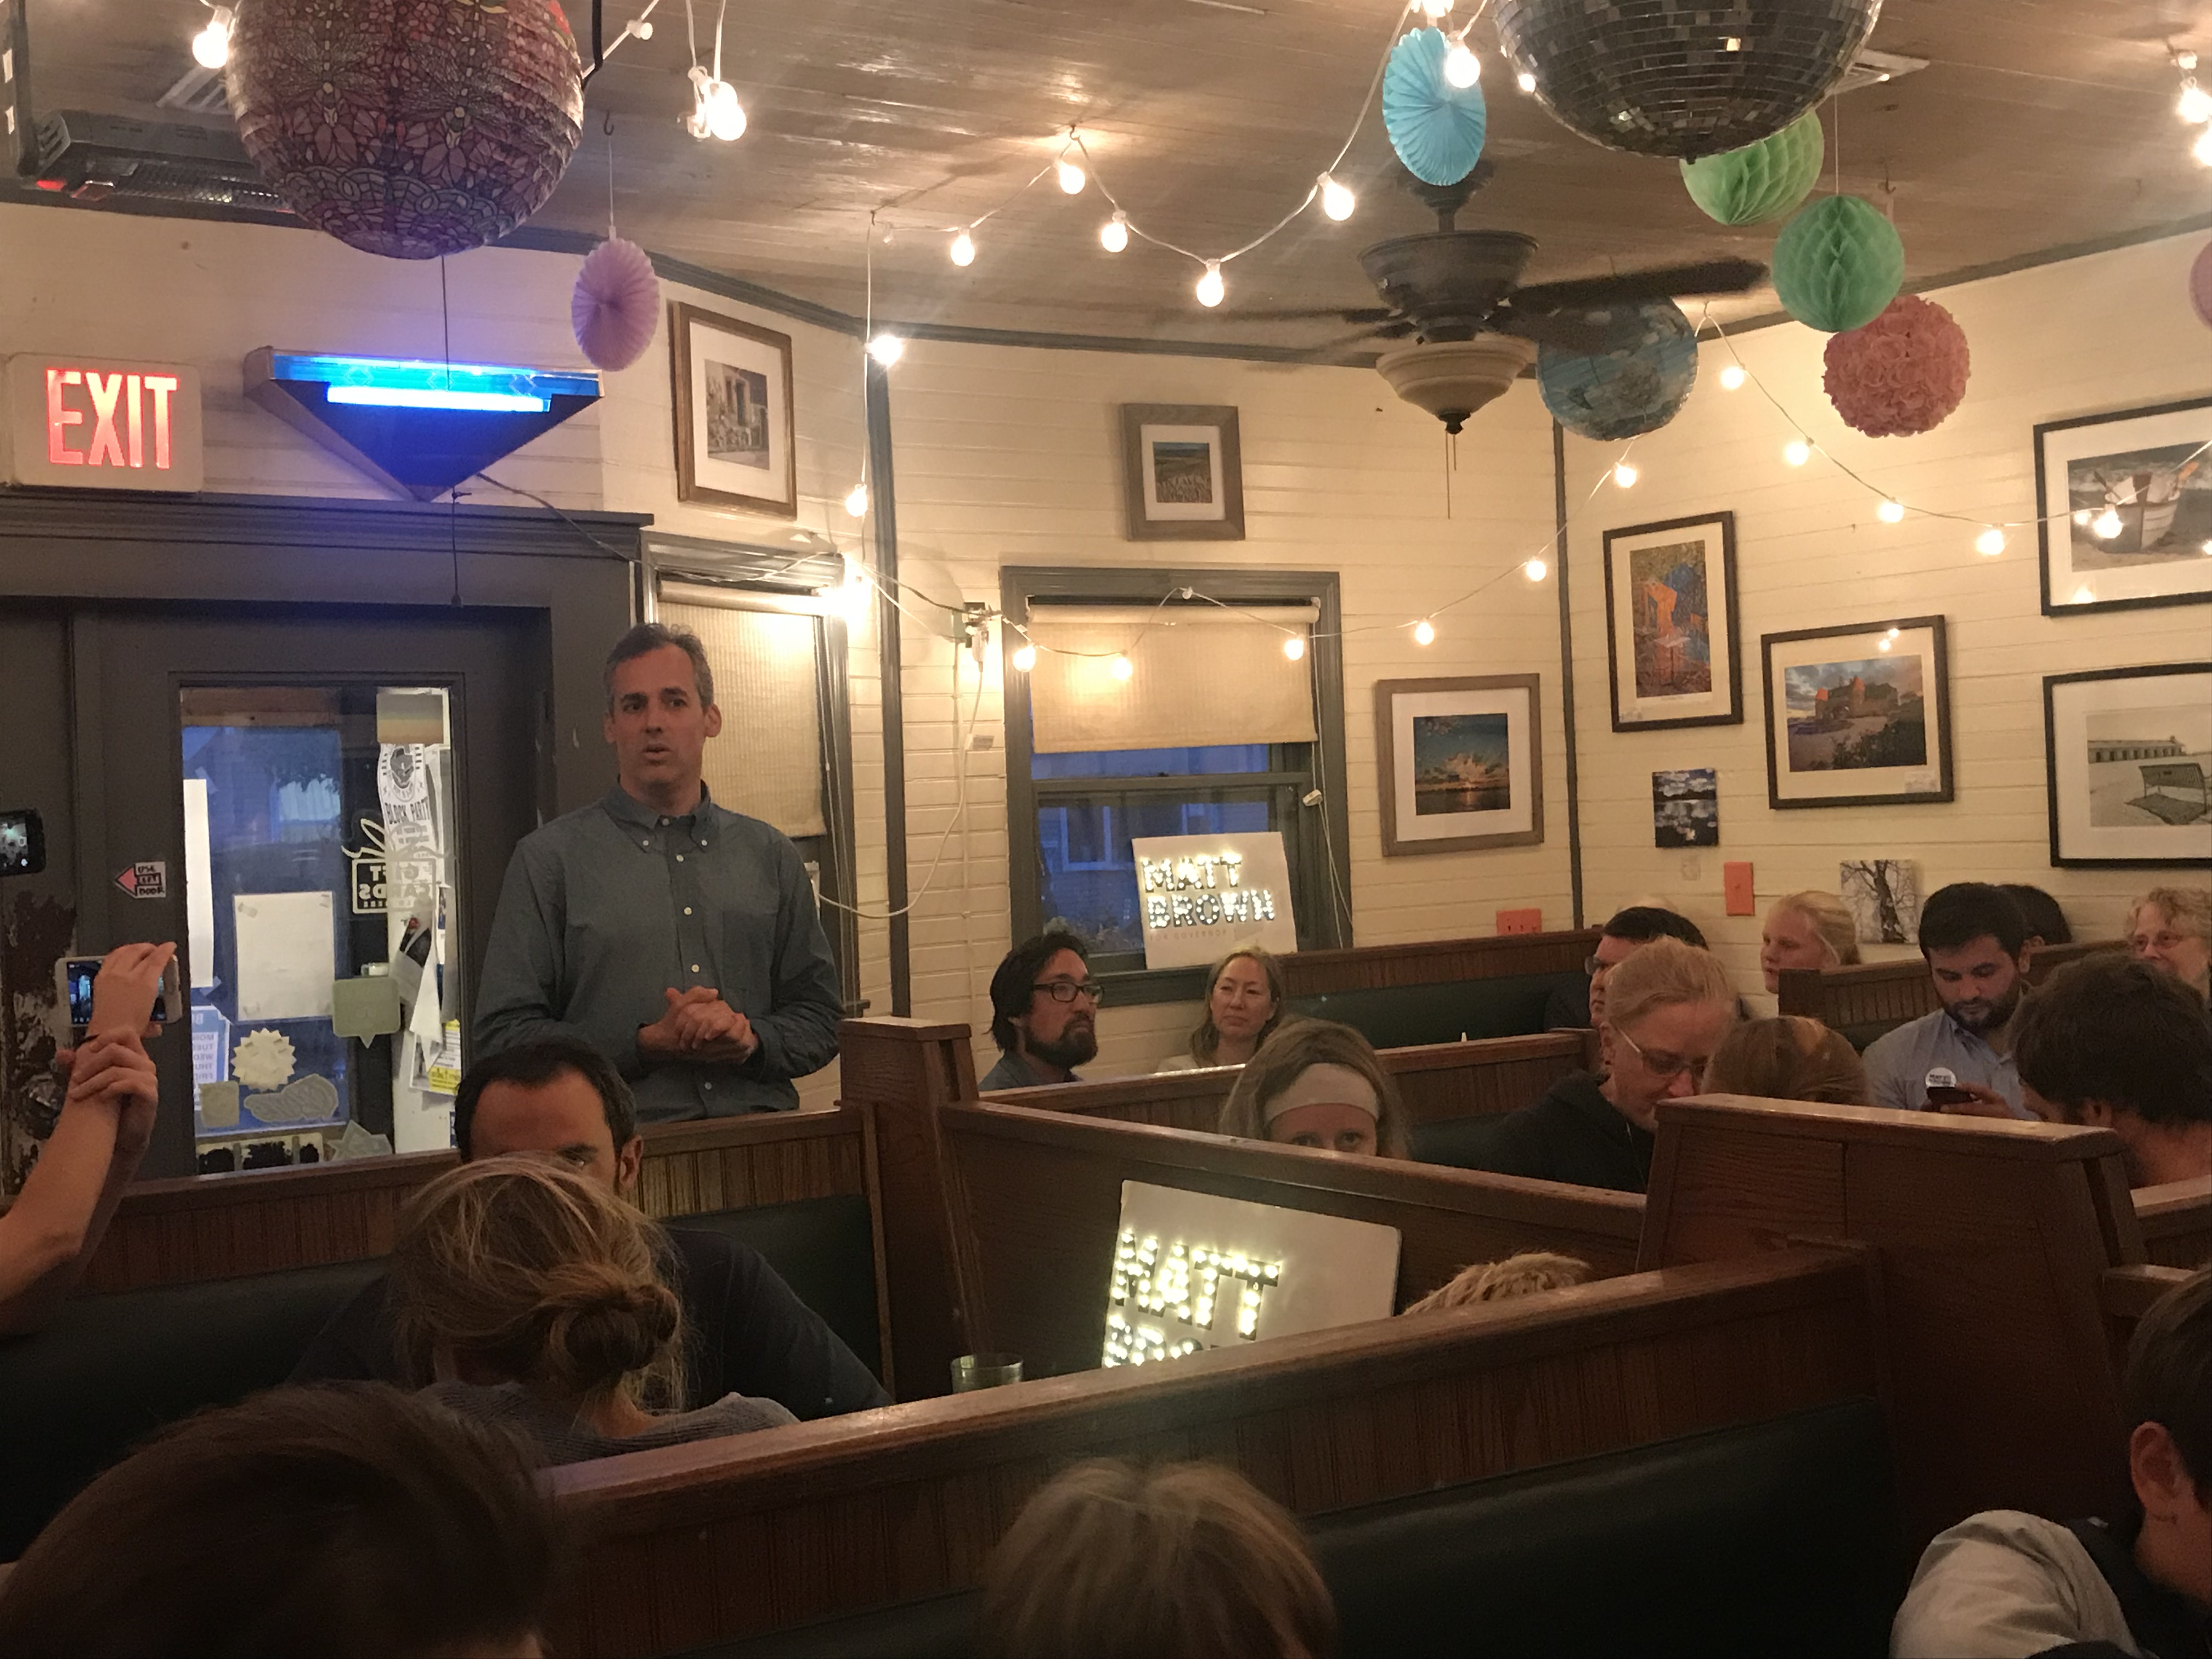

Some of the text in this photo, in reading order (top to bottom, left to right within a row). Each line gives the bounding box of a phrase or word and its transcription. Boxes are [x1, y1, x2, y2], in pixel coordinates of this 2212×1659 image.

[46, 368, 179, 469] EXIT
[1142, 853, 1242, 893] MATT
[1147, 890, 1275, 929] BROWN
[1112, 1232, 1280, 1341] MATT
